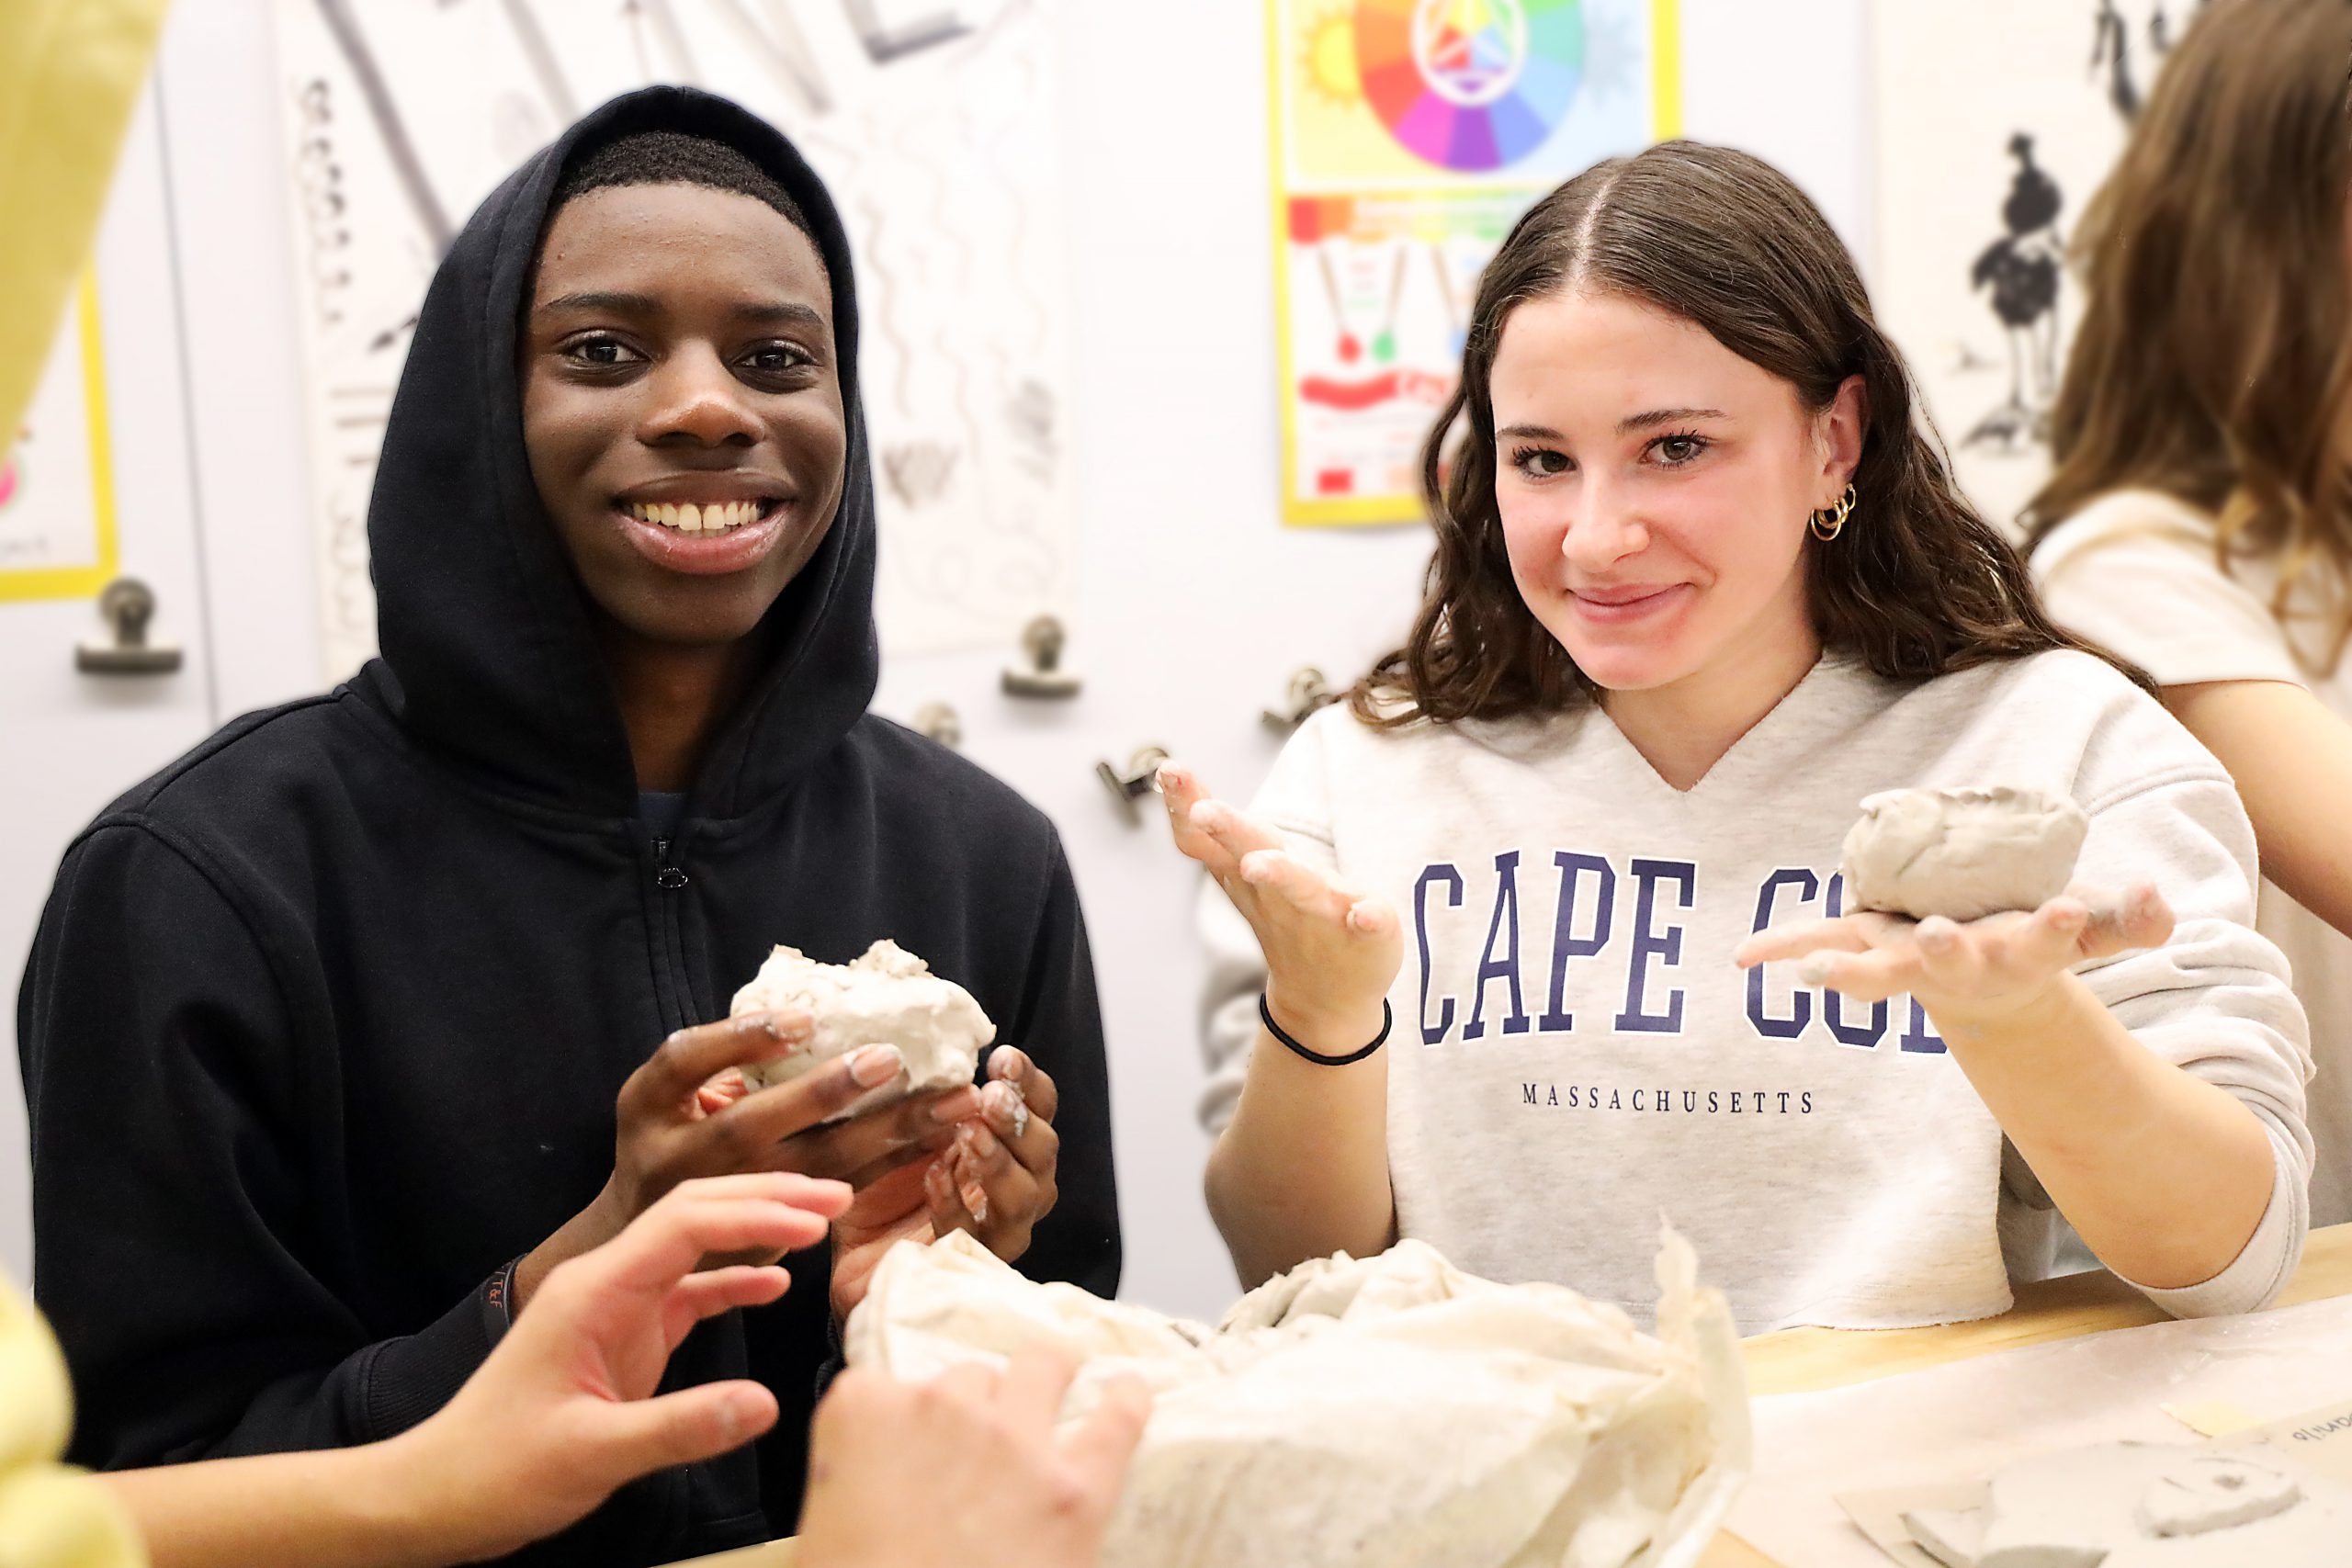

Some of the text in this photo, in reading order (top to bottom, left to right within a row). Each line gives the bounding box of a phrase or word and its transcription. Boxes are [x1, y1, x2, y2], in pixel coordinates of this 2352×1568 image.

[1413, 849, 1698, 1046] CAPE
[1522, 1083, 1813, 1114] MASSACHUSETTS
[2292, 1411, 2352, 1441] anilo
